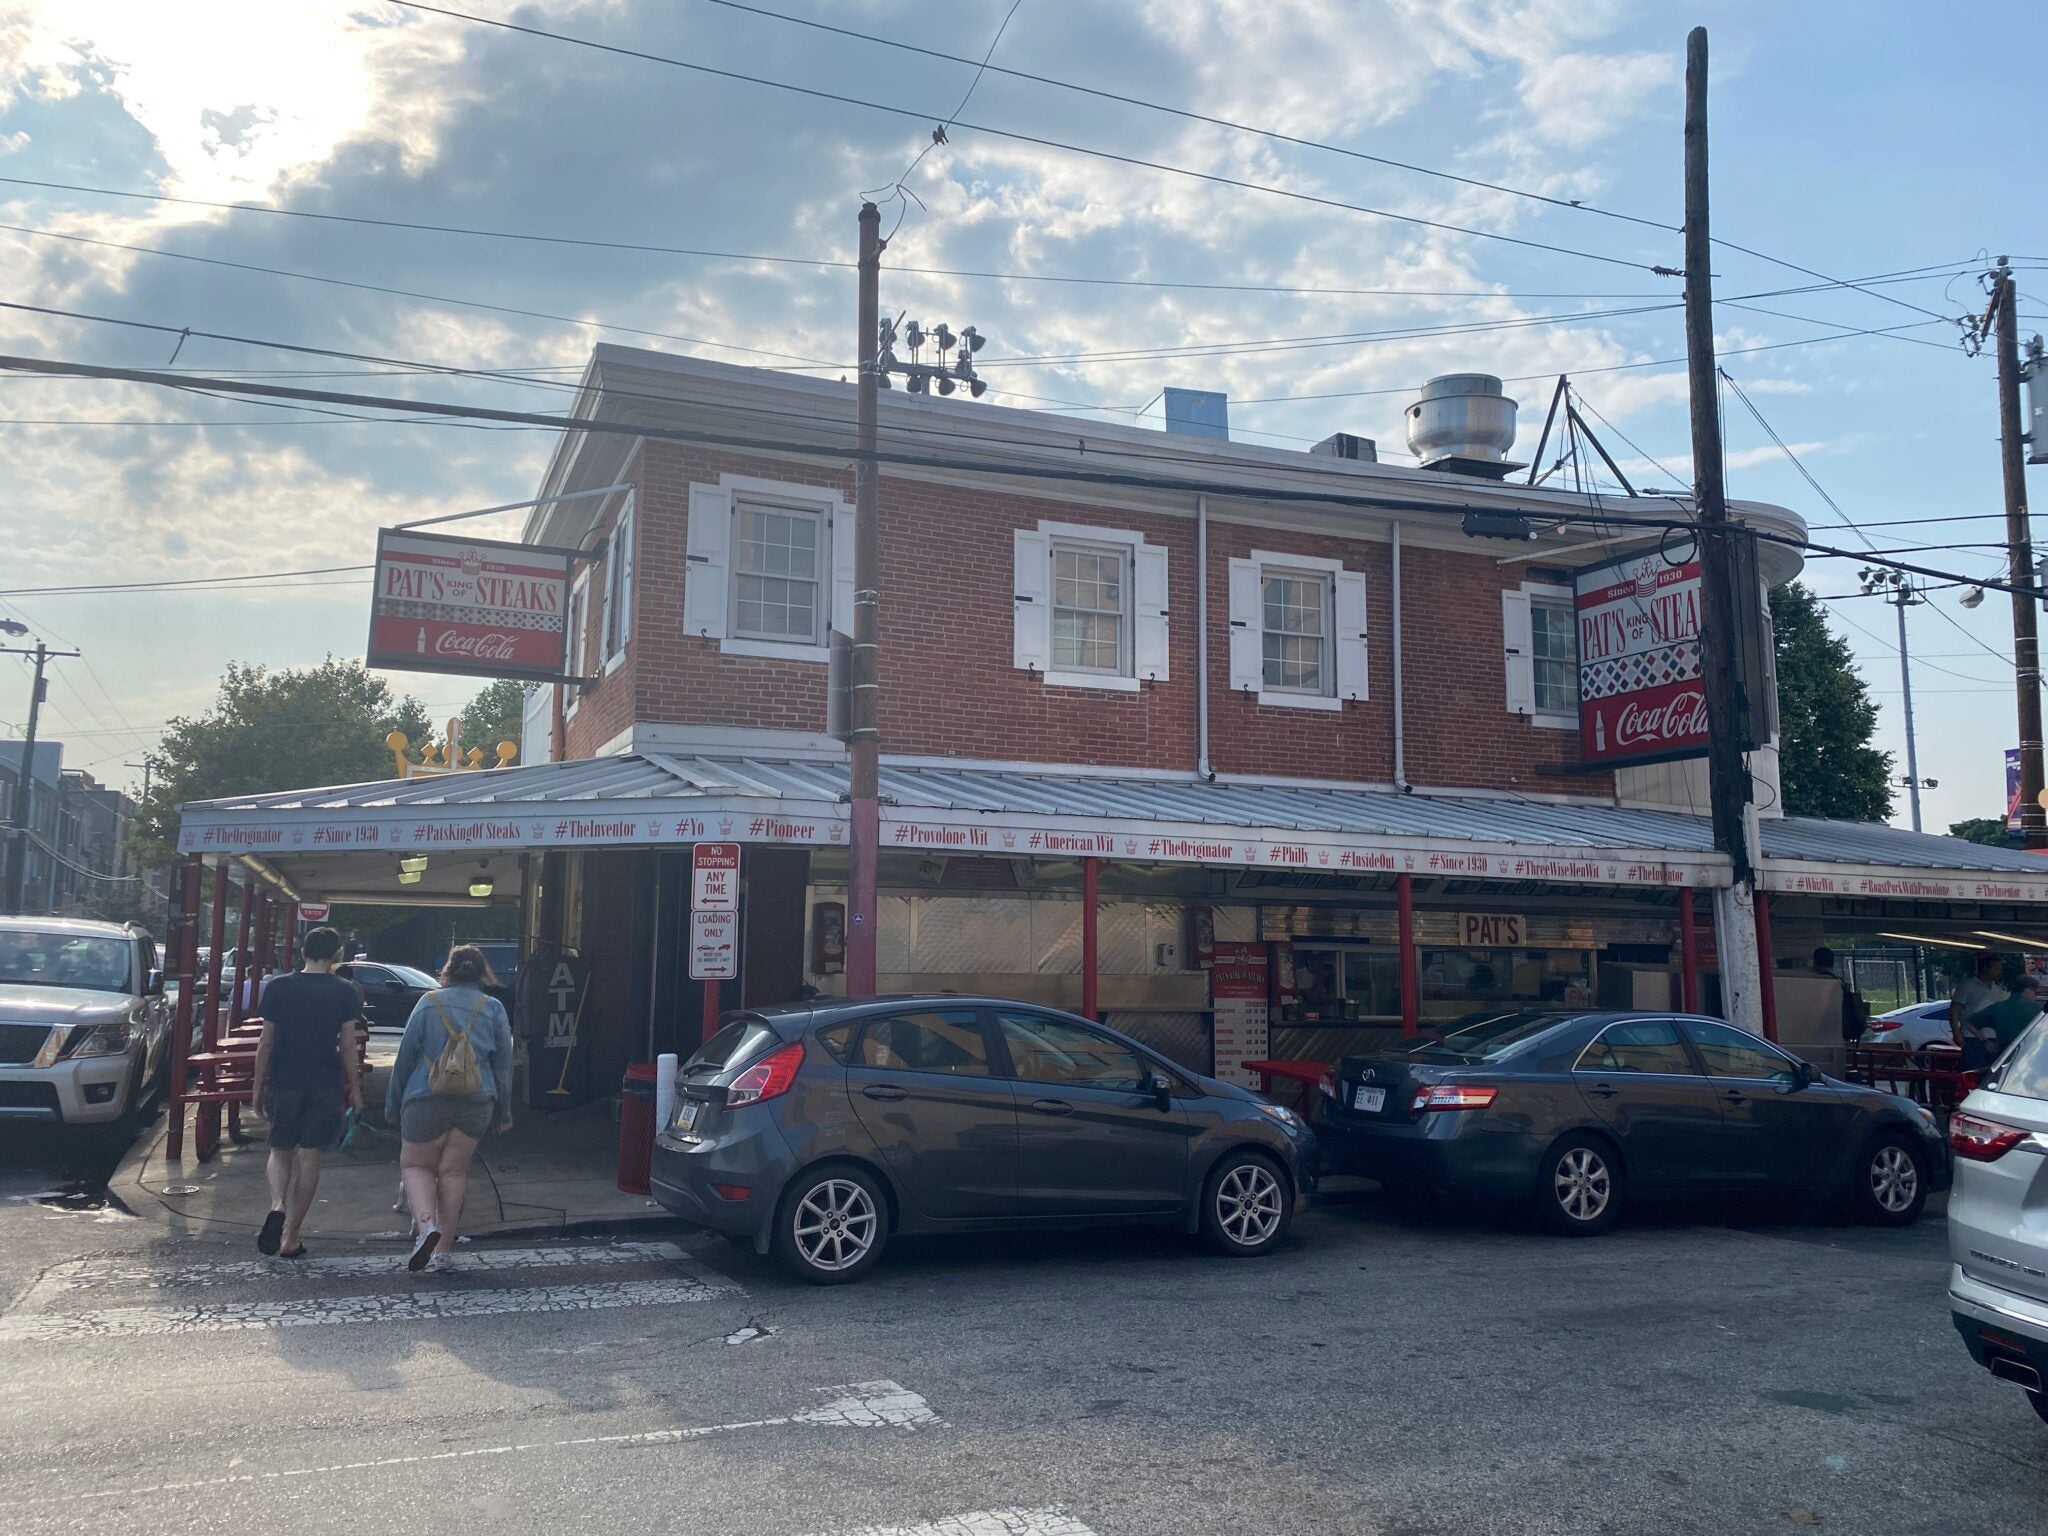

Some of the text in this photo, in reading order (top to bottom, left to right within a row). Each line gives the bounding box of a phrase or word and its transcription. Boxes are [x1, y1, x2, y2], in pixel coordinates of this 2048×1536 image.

[386, 567, 557, 612] PAT'S KING OF STEAKS
[1608, 570, 1682, 598] Since 1930
[1582, 587, 1702, 662] PAT'S KING OF STEA
[435, 629, 520, 660] Coca-Cola
[203, 824, 283, 847] #TheOriginator
[313, 826, 352, 844] #Since
[354, 825, 379, 843] 1930
[486, 822, 520, 840] Steaks
[554, 819, 636, 839] #TheInventor
[675, 817, 705, 837] #Yo
[749, 818, 816, 840] #Pioneer
[698, 858, 735, 866] STOPPING
[711, 846, 722, 856] NO
[894, 824, 1684, 883] #Provolone Wit #American Wit #TheOriginator #Philly #InsideOut #Since 1930 #ThreeWiseMenWit #TheInventor
[704, 884, 727, 895] TIME
[706, 872, 726, 882] ANY
[1797, 876, 1834, 892] #WhizWit
[698, 915, 732, 924] LOADING
[1466, 916, 1520, 944] PAT'S
[704, 928, 724, 938] ONLY
[548, 963, 576, 1037] ATM
